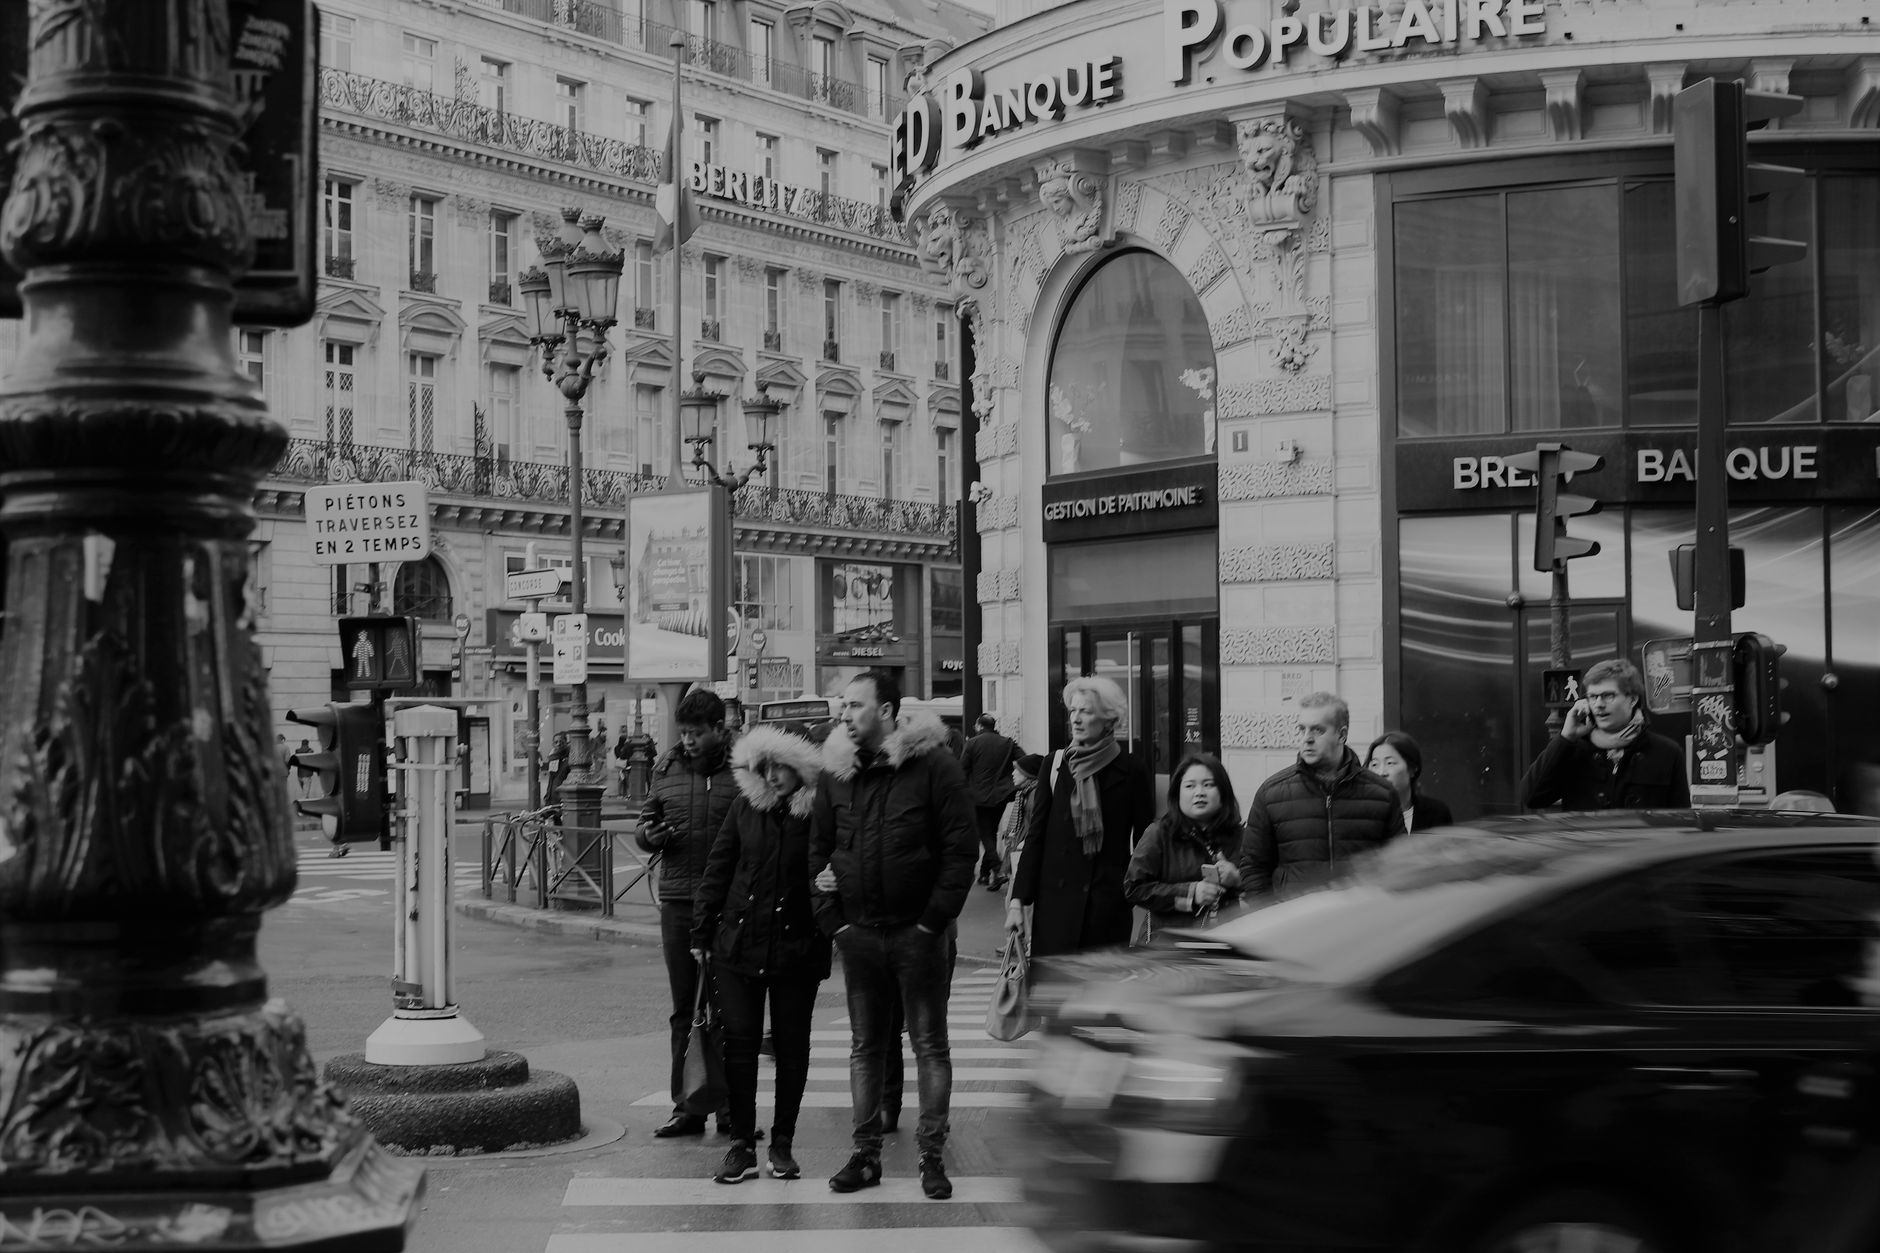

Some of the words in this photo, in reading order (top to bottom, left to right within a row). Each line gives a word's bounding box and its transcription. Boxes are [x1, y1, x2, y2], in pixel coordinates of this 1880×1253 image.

[947, 56, 1121, 148] BANQUE
[1169, 0, 1546, 83] POPULAIRE
[689, 161, 806, 213] BERLITZ
[1453, 456, 1538, 489] BRE
[1637, 446, 1818, 481] BAQUE
[325, 493, 406, 512] PIÉTONS
[1044, 498, 1095, 521] GESTION
[1099, 495, 1116, 516] DE
[1117, 486, 1198, 513] PATRIMOINE
[316, 514, 419, 534] TRAVERSEZ
[316, 540, 337, 555] EN
[345, 540, 355, 554] 2
[363, 536, 421, 554] TEMPS
[595, 627, 625, 647] Cook
[851, 646, 885, 657] DIESEL
